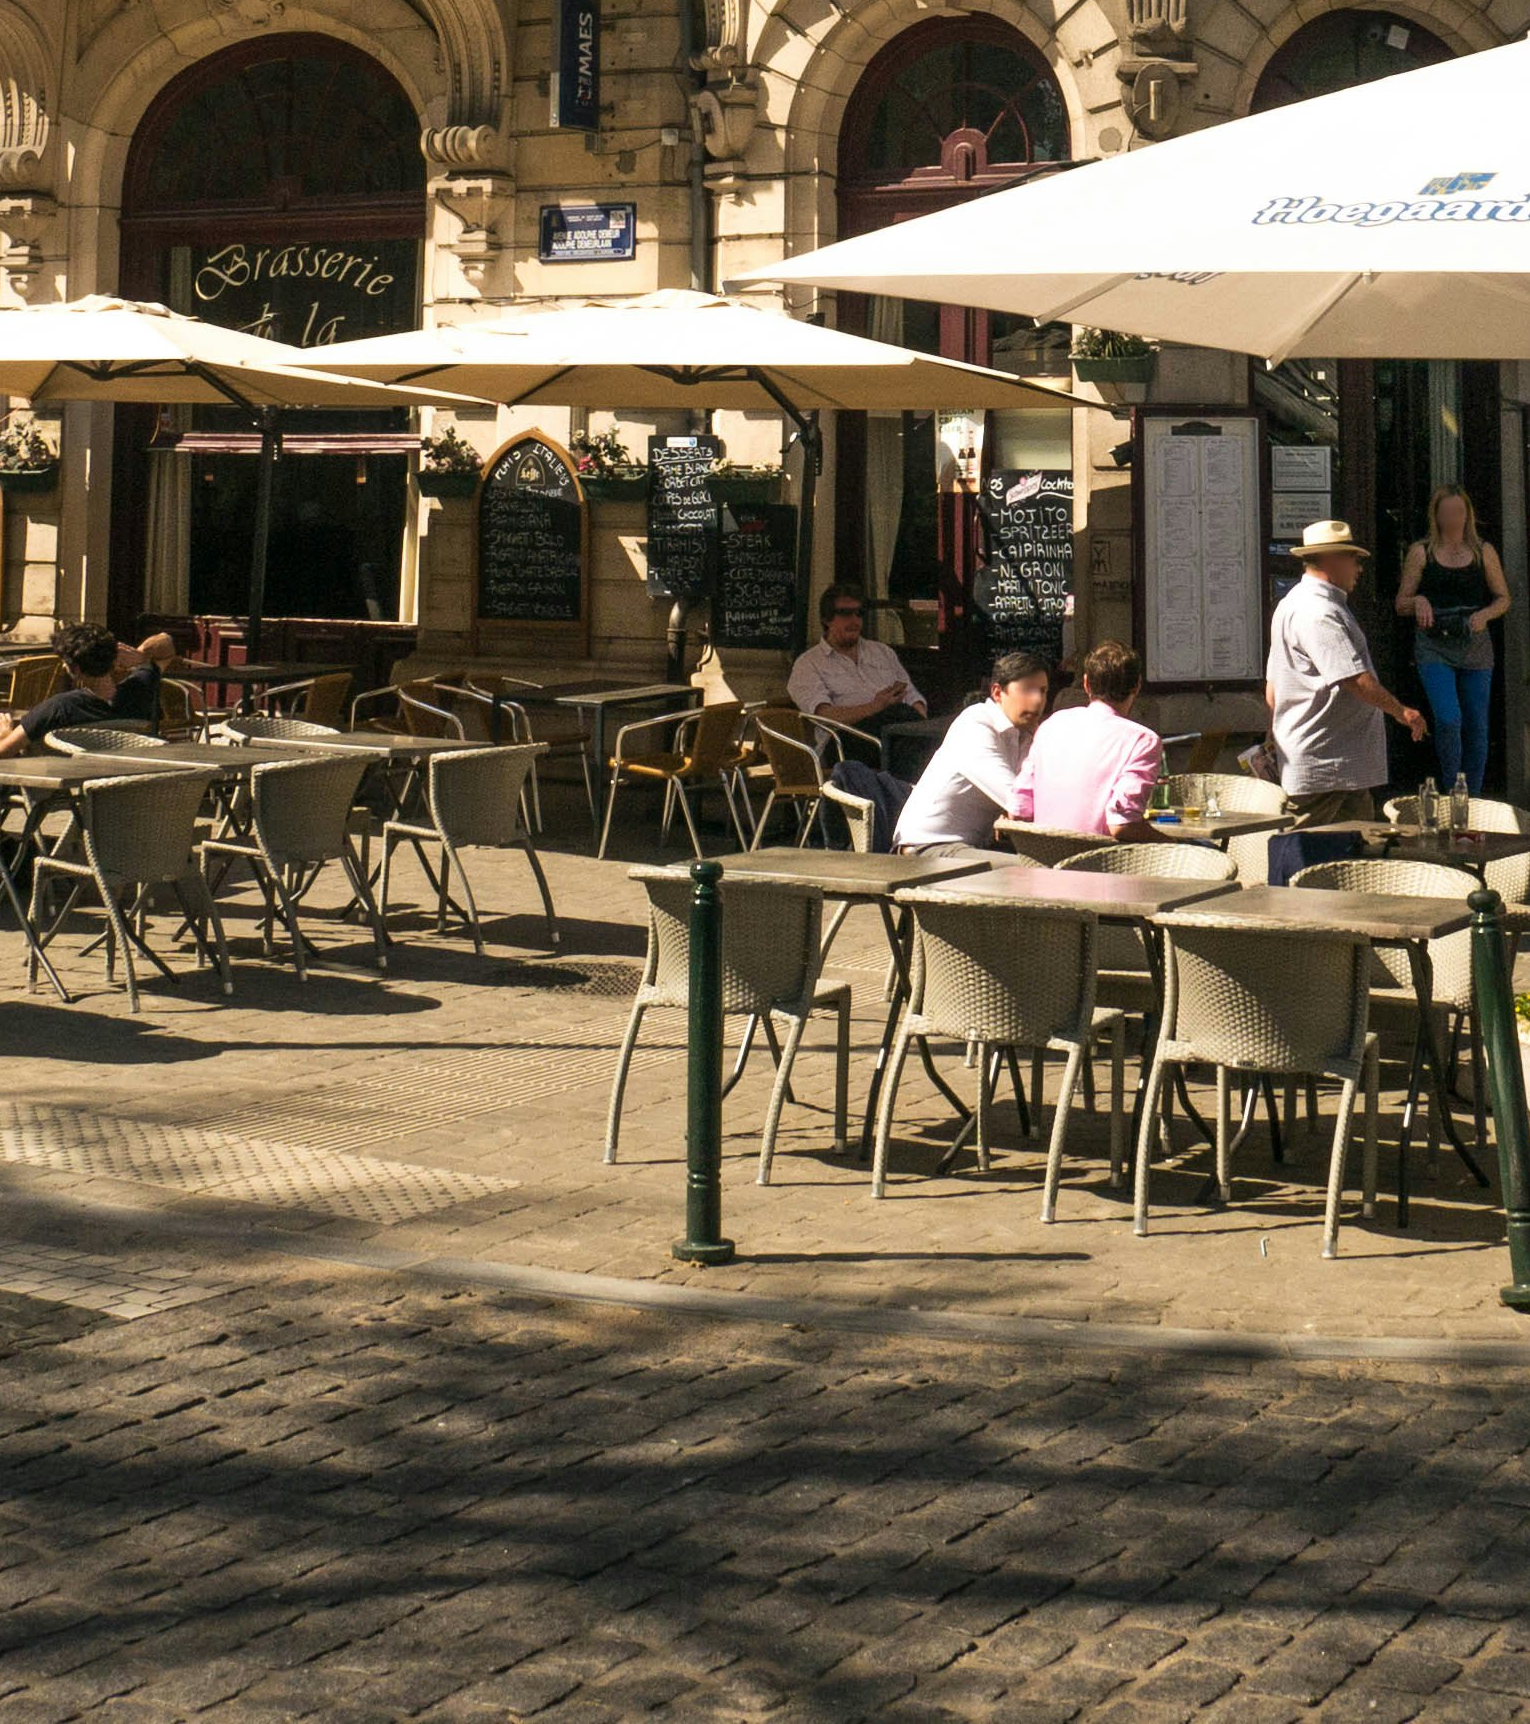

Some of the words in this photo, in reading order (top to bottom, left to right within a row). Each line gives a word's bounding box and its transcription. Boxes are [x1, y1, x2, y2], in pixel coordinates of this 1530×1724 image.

[579, 12, 594, 77] MAES
[195, 243, 395, 301] Brasserie
[652, 446, 714, 463] DESSERTS
[677, 507, 716, 521] CHOCOLAT
